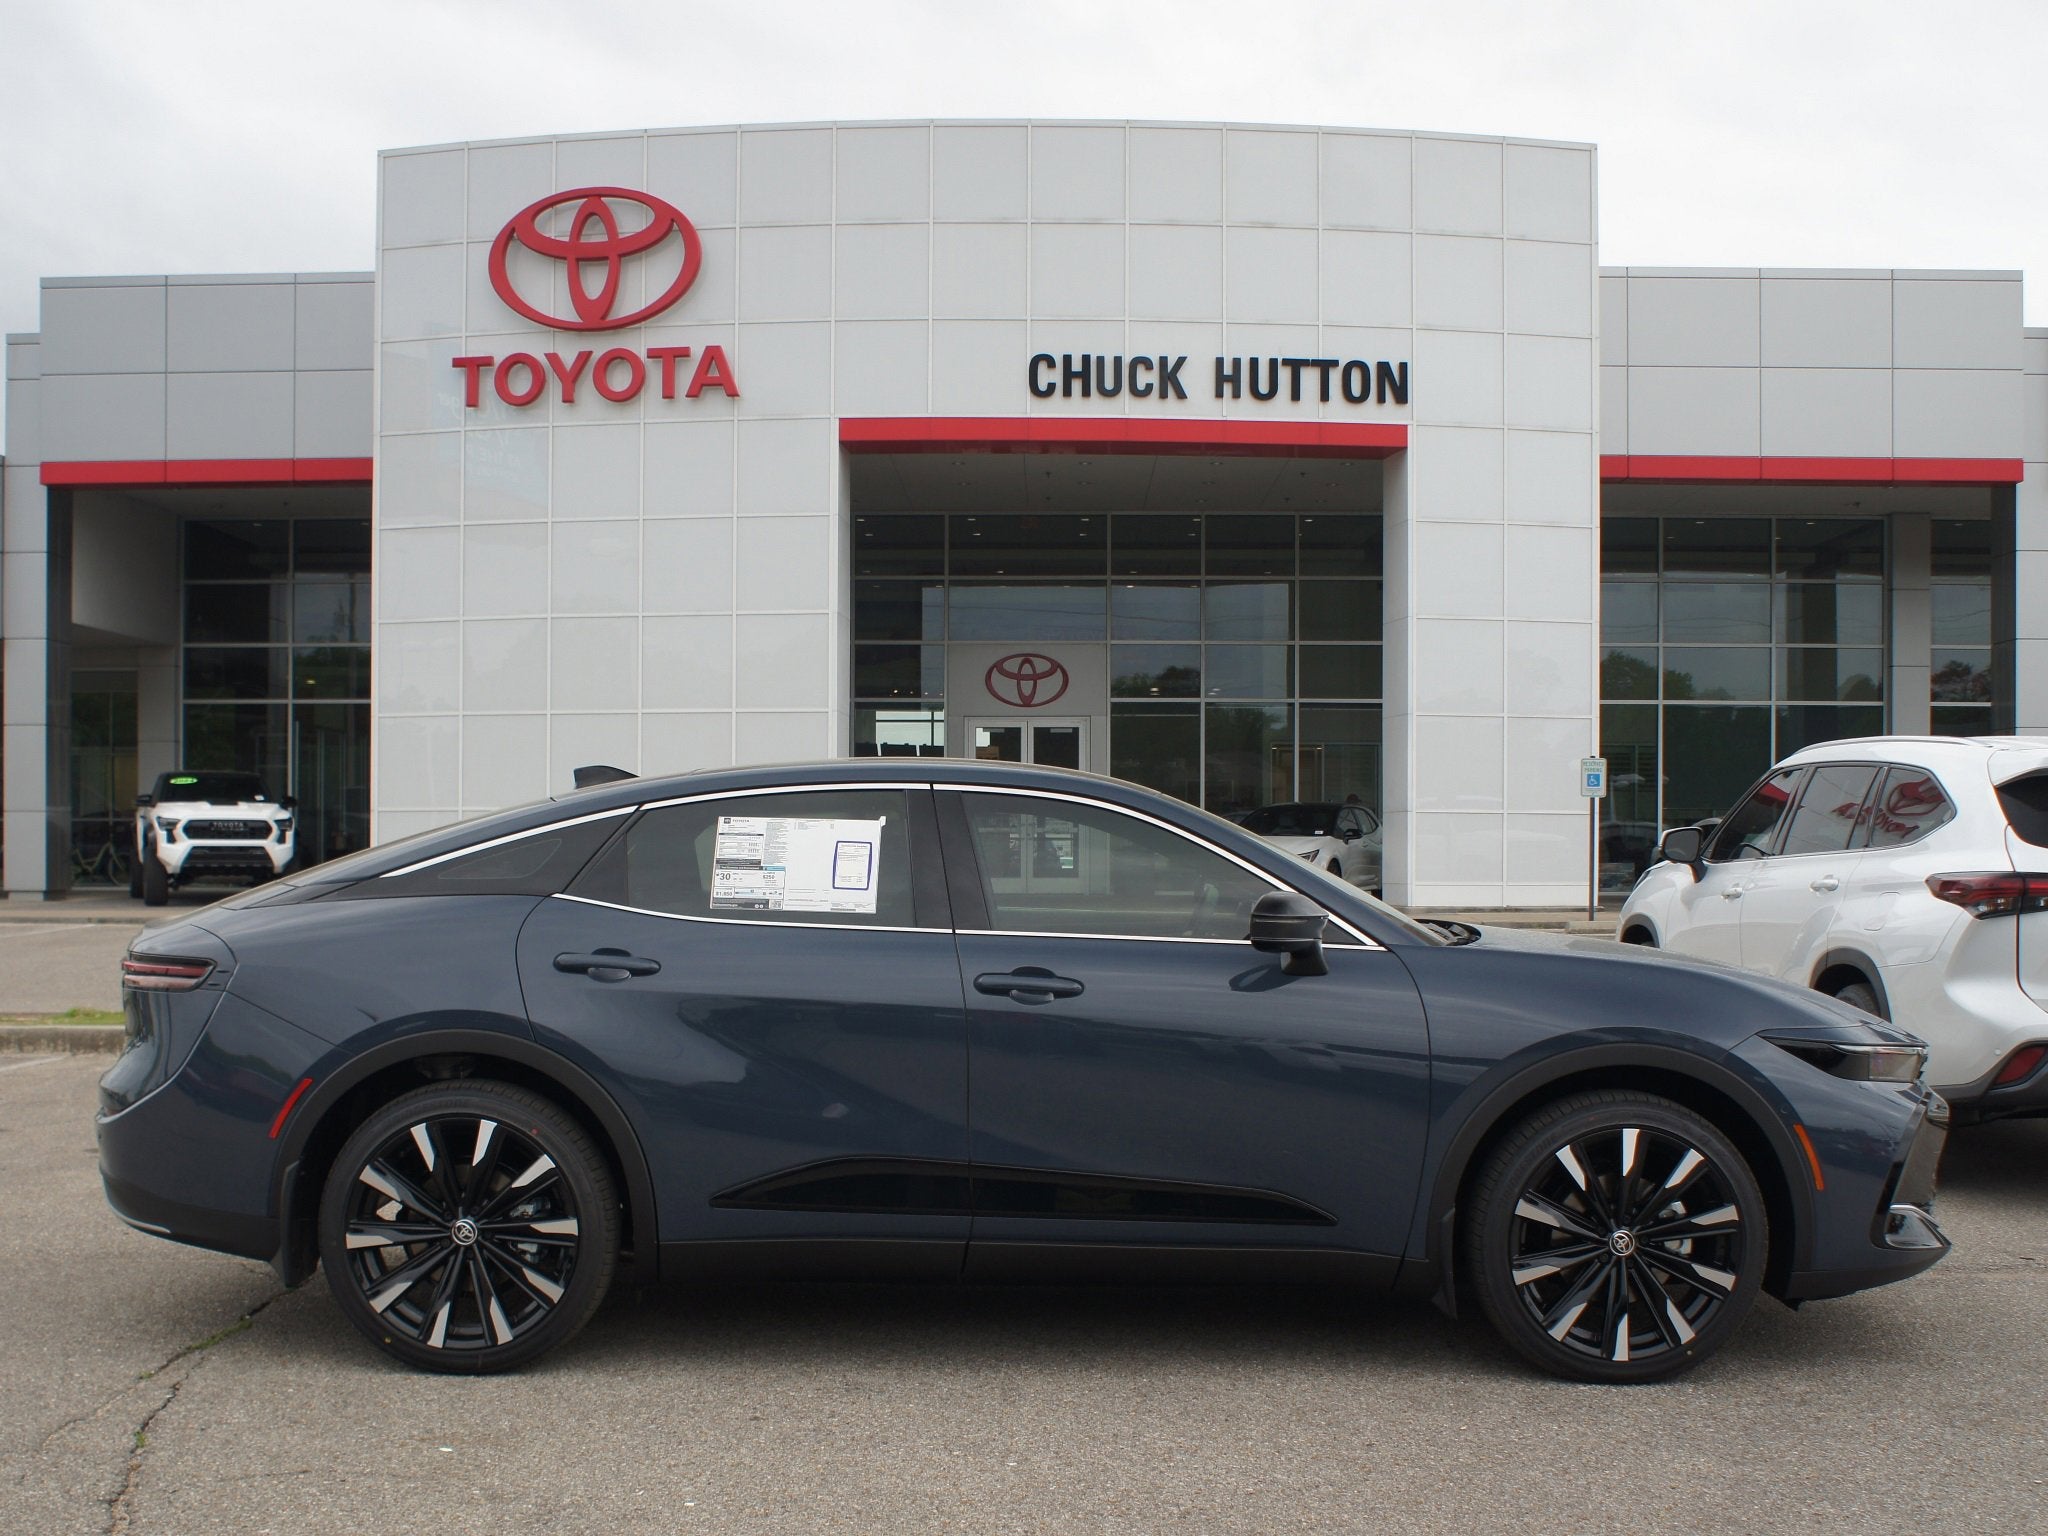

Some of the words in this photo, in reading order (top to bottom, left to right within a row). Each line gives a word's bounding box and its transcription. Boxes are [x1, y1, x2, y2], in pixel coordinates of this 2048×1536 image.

[452, 345, 740, 408] TOYOTA
[1028, 353, 1188, 400] CHUCK
[1214, 356, 1409, 405] HUTTON
[719, 872, 731, 880] 30
